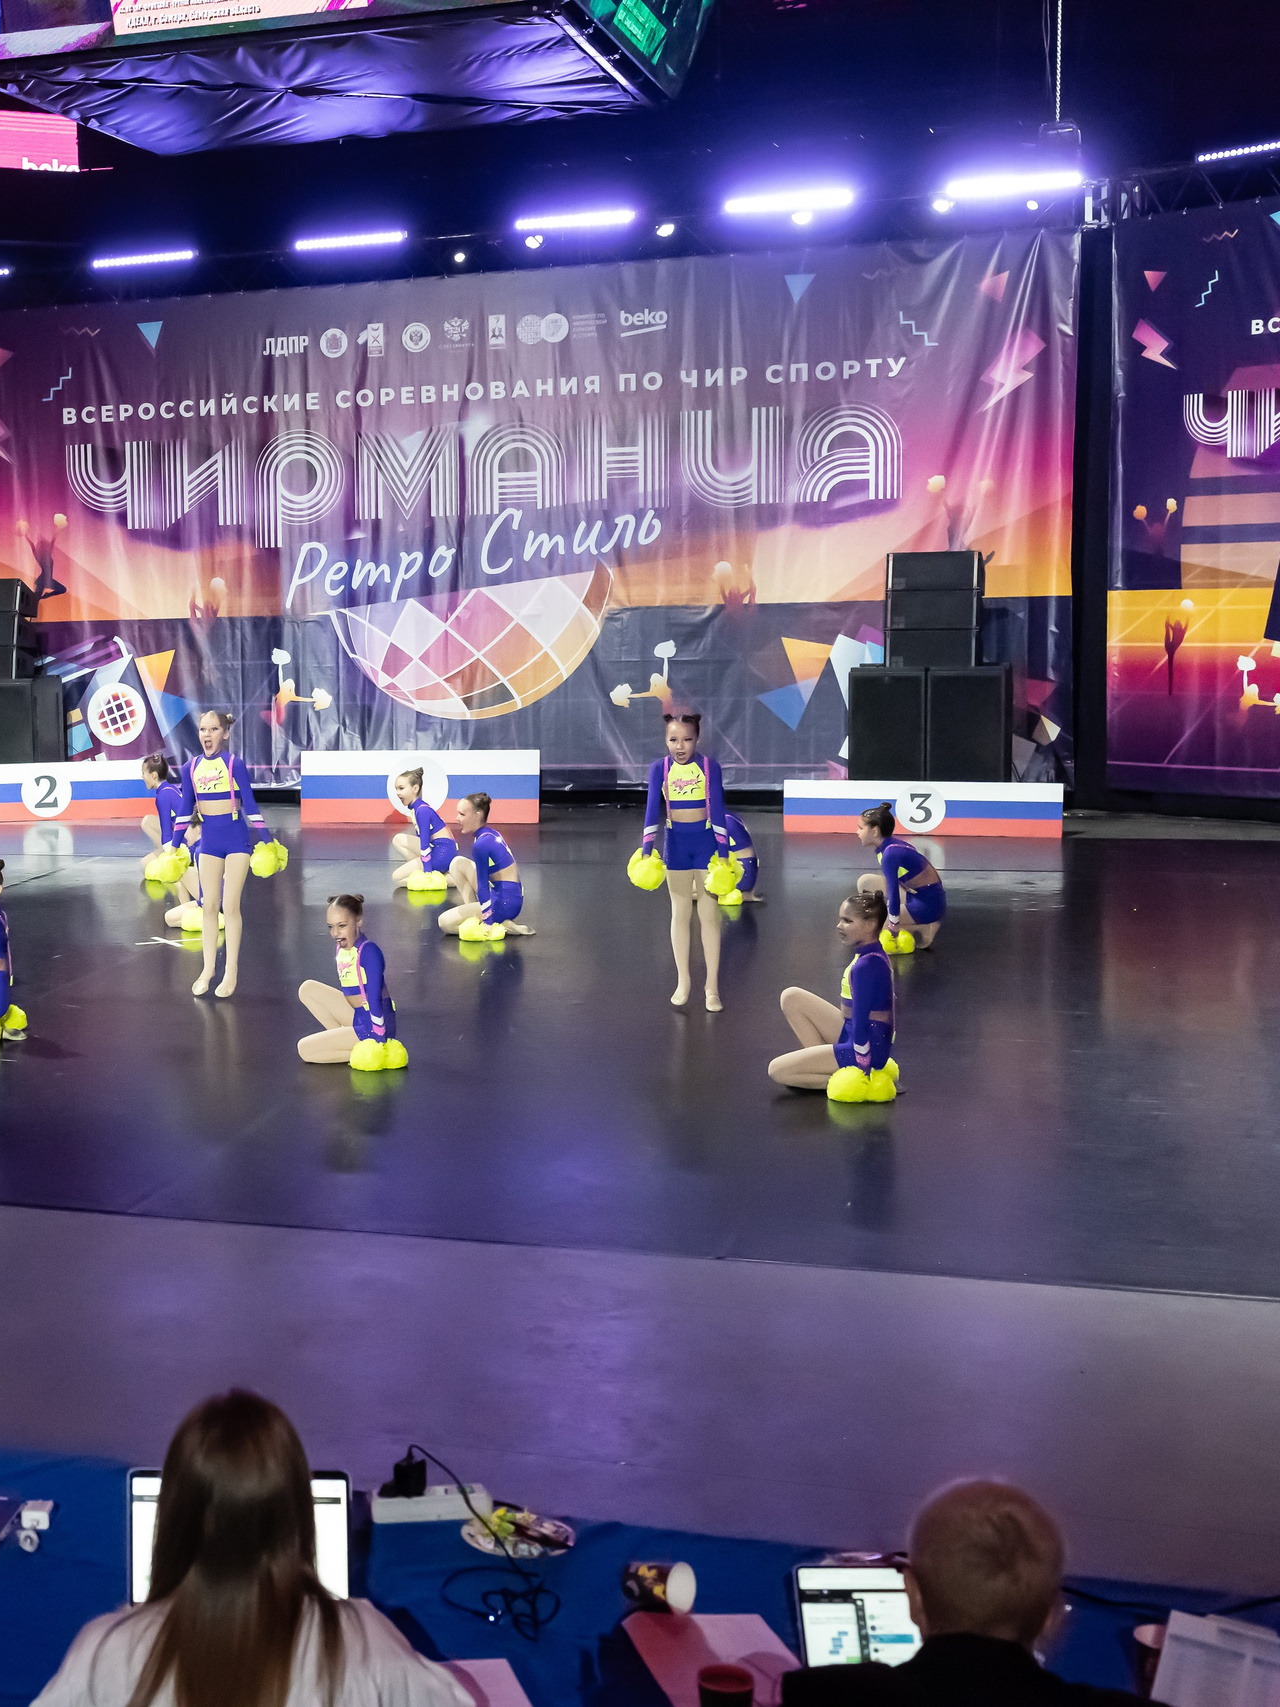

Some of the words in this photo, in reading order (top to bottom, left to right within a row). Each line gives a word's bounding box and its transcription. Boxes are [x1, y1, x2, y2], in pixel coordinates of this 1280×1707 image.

[620, 308, 668, 327] beko
[263, 335, 309, 357] ЛДПР
[61, 392, 321, 425] ВСЕРОССИЙСКИЕ
[335, 374, 601, 409] СОРЕВНОВАНИЯ
[619, 371, 663, 392] ПО
[680, 366, 748, 388] ЧИР
[765, 356, 907, 384] СПОРТУ
[285, 541, 457, 609] Ретро
[480, 507, 662, 576] Стиль
[34, 775, 58, 808] 2
[909, 793, 932, 824] 3
